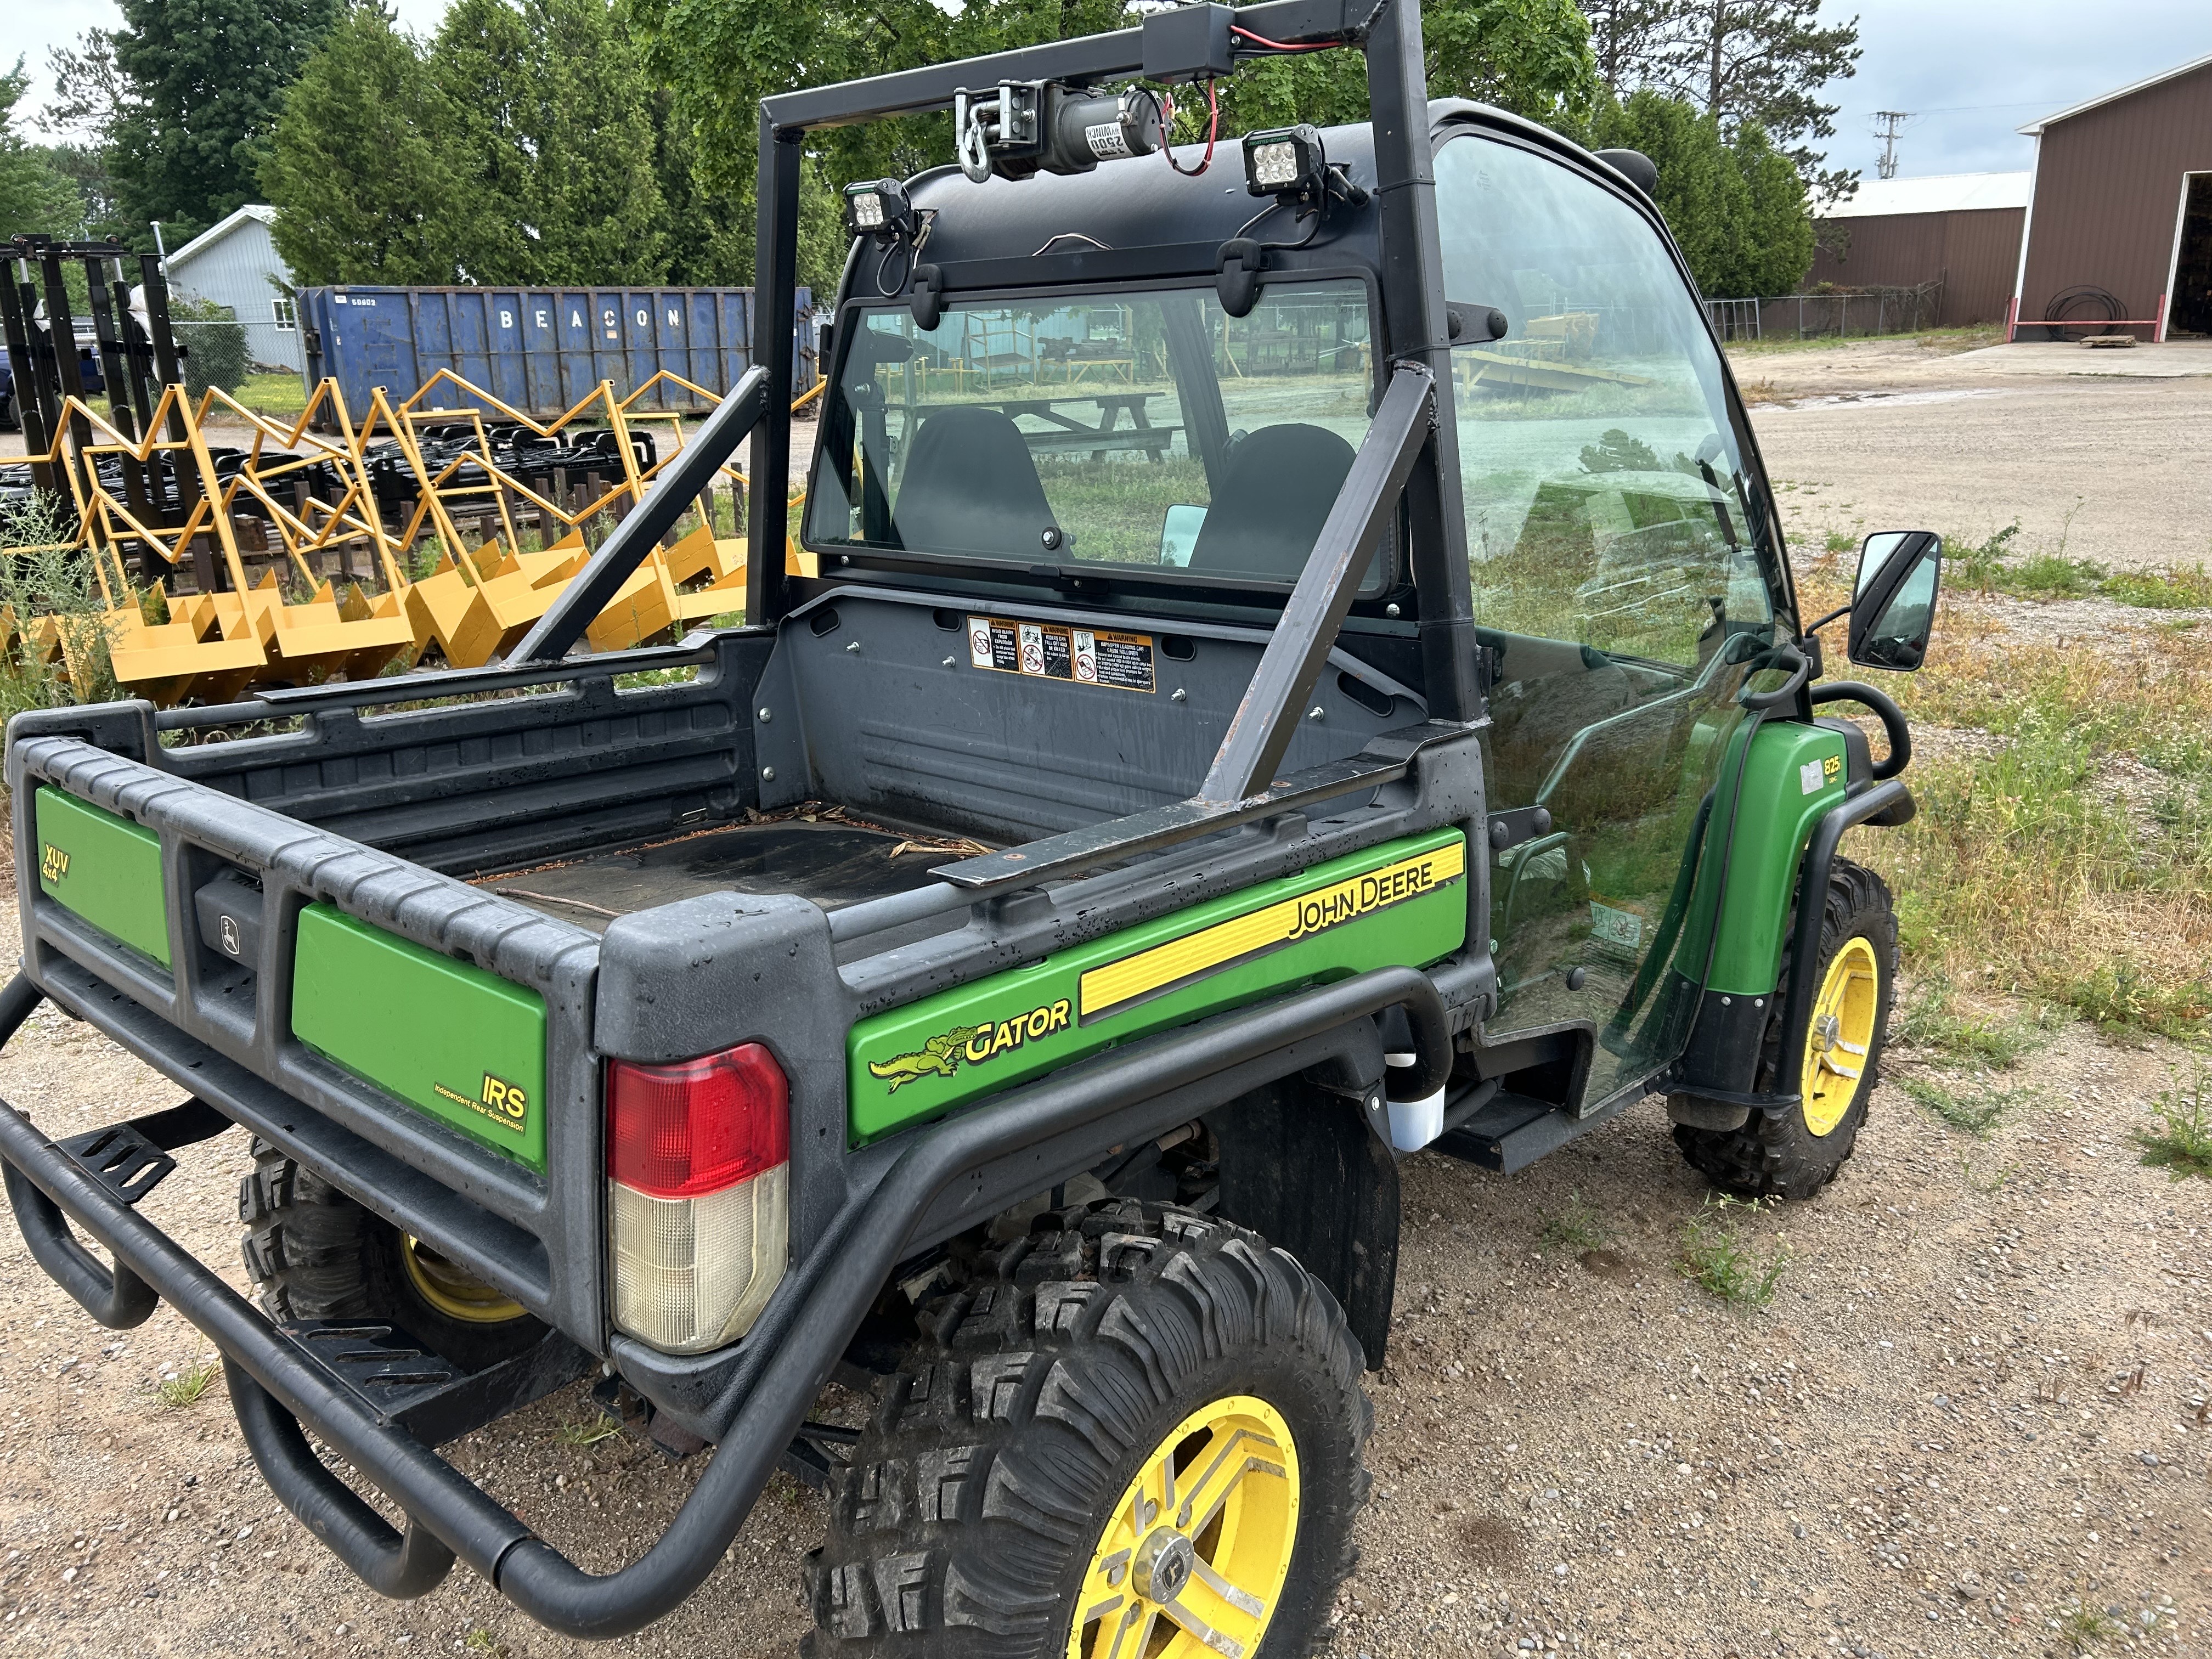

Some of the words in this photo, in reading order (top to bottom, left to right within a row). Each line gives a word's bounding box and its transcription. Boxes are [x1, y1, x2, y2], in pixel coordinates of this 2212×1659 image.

[1087, 126, 1112, 139] WINCH
[1090, 136, 1124, 150] 2500
[500, 309, 679, 328] BEACON
[995, 620, 1015, 629] WARNING
[1048, 626, 1069, 635] WARNING
[1113, 634, 1138, 644] WARNING
[45, 844, 69, 873] XUV
[42, 862, 58, 883] 4x4
[1289, 889, 1354, 936] JOHN
[1361, 861, 1433, 909] DEERE
[964, 998, 1070, 1063] GATOR
[482, 1075, 526, 1118] IRS
[435, 1084, 470, 1108] Independent
[471, 1101, 487, 1115] Rear
[487, 1109, 523, 1132] Suspension
